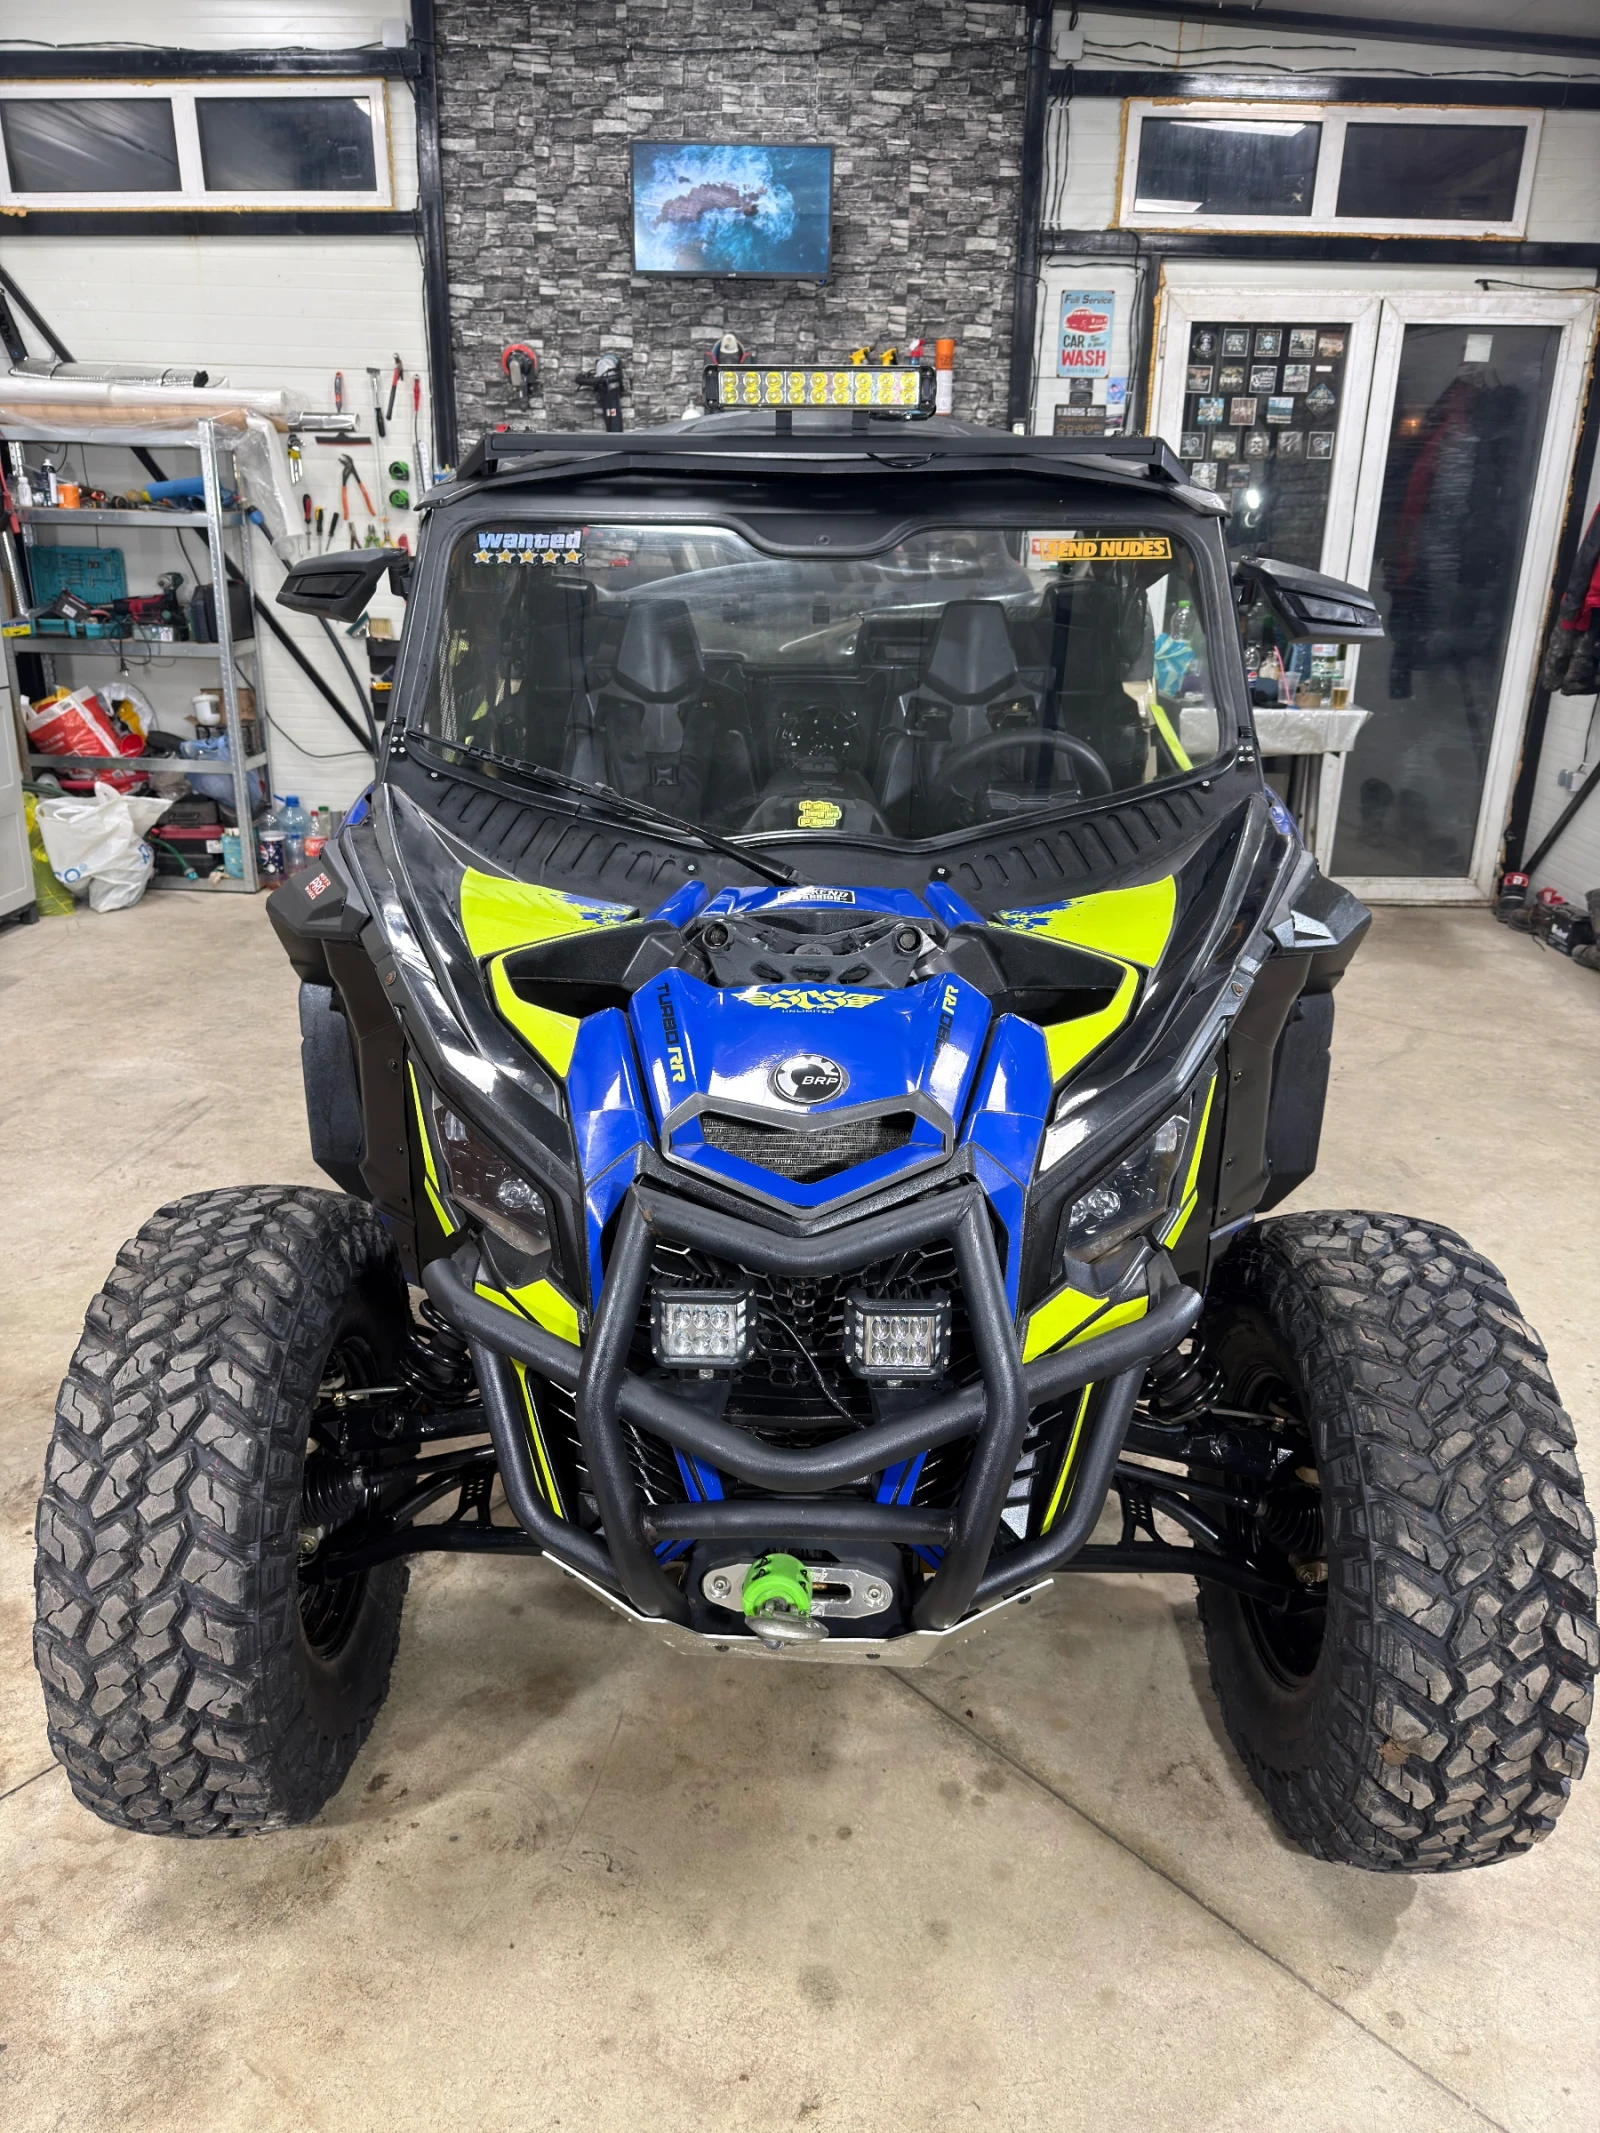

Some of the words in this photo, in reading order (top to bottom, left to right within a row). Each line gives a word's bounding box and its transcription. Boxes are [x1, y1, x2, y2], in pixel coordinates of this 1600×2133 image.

[1064, 294, 1080, 304] Full
[1082, 295, 1113, 304] Service
[1063, 335, 1085, 348] CAR
[1061, 349, 1106, 367] WASH
[1046, 541, 1097, 558] SEND
[1100, 540, 1166, 557] NUDES
[768, 988, 848, 1010] SCS
[941, 984, 959, 1016] RR
[656, 982, 680, 1045] TURBO
[930, 1013, 954, 1075] RBO
[667, 1046, 687, 1083] RR
[802, 1076, 839, 1085] BRP
